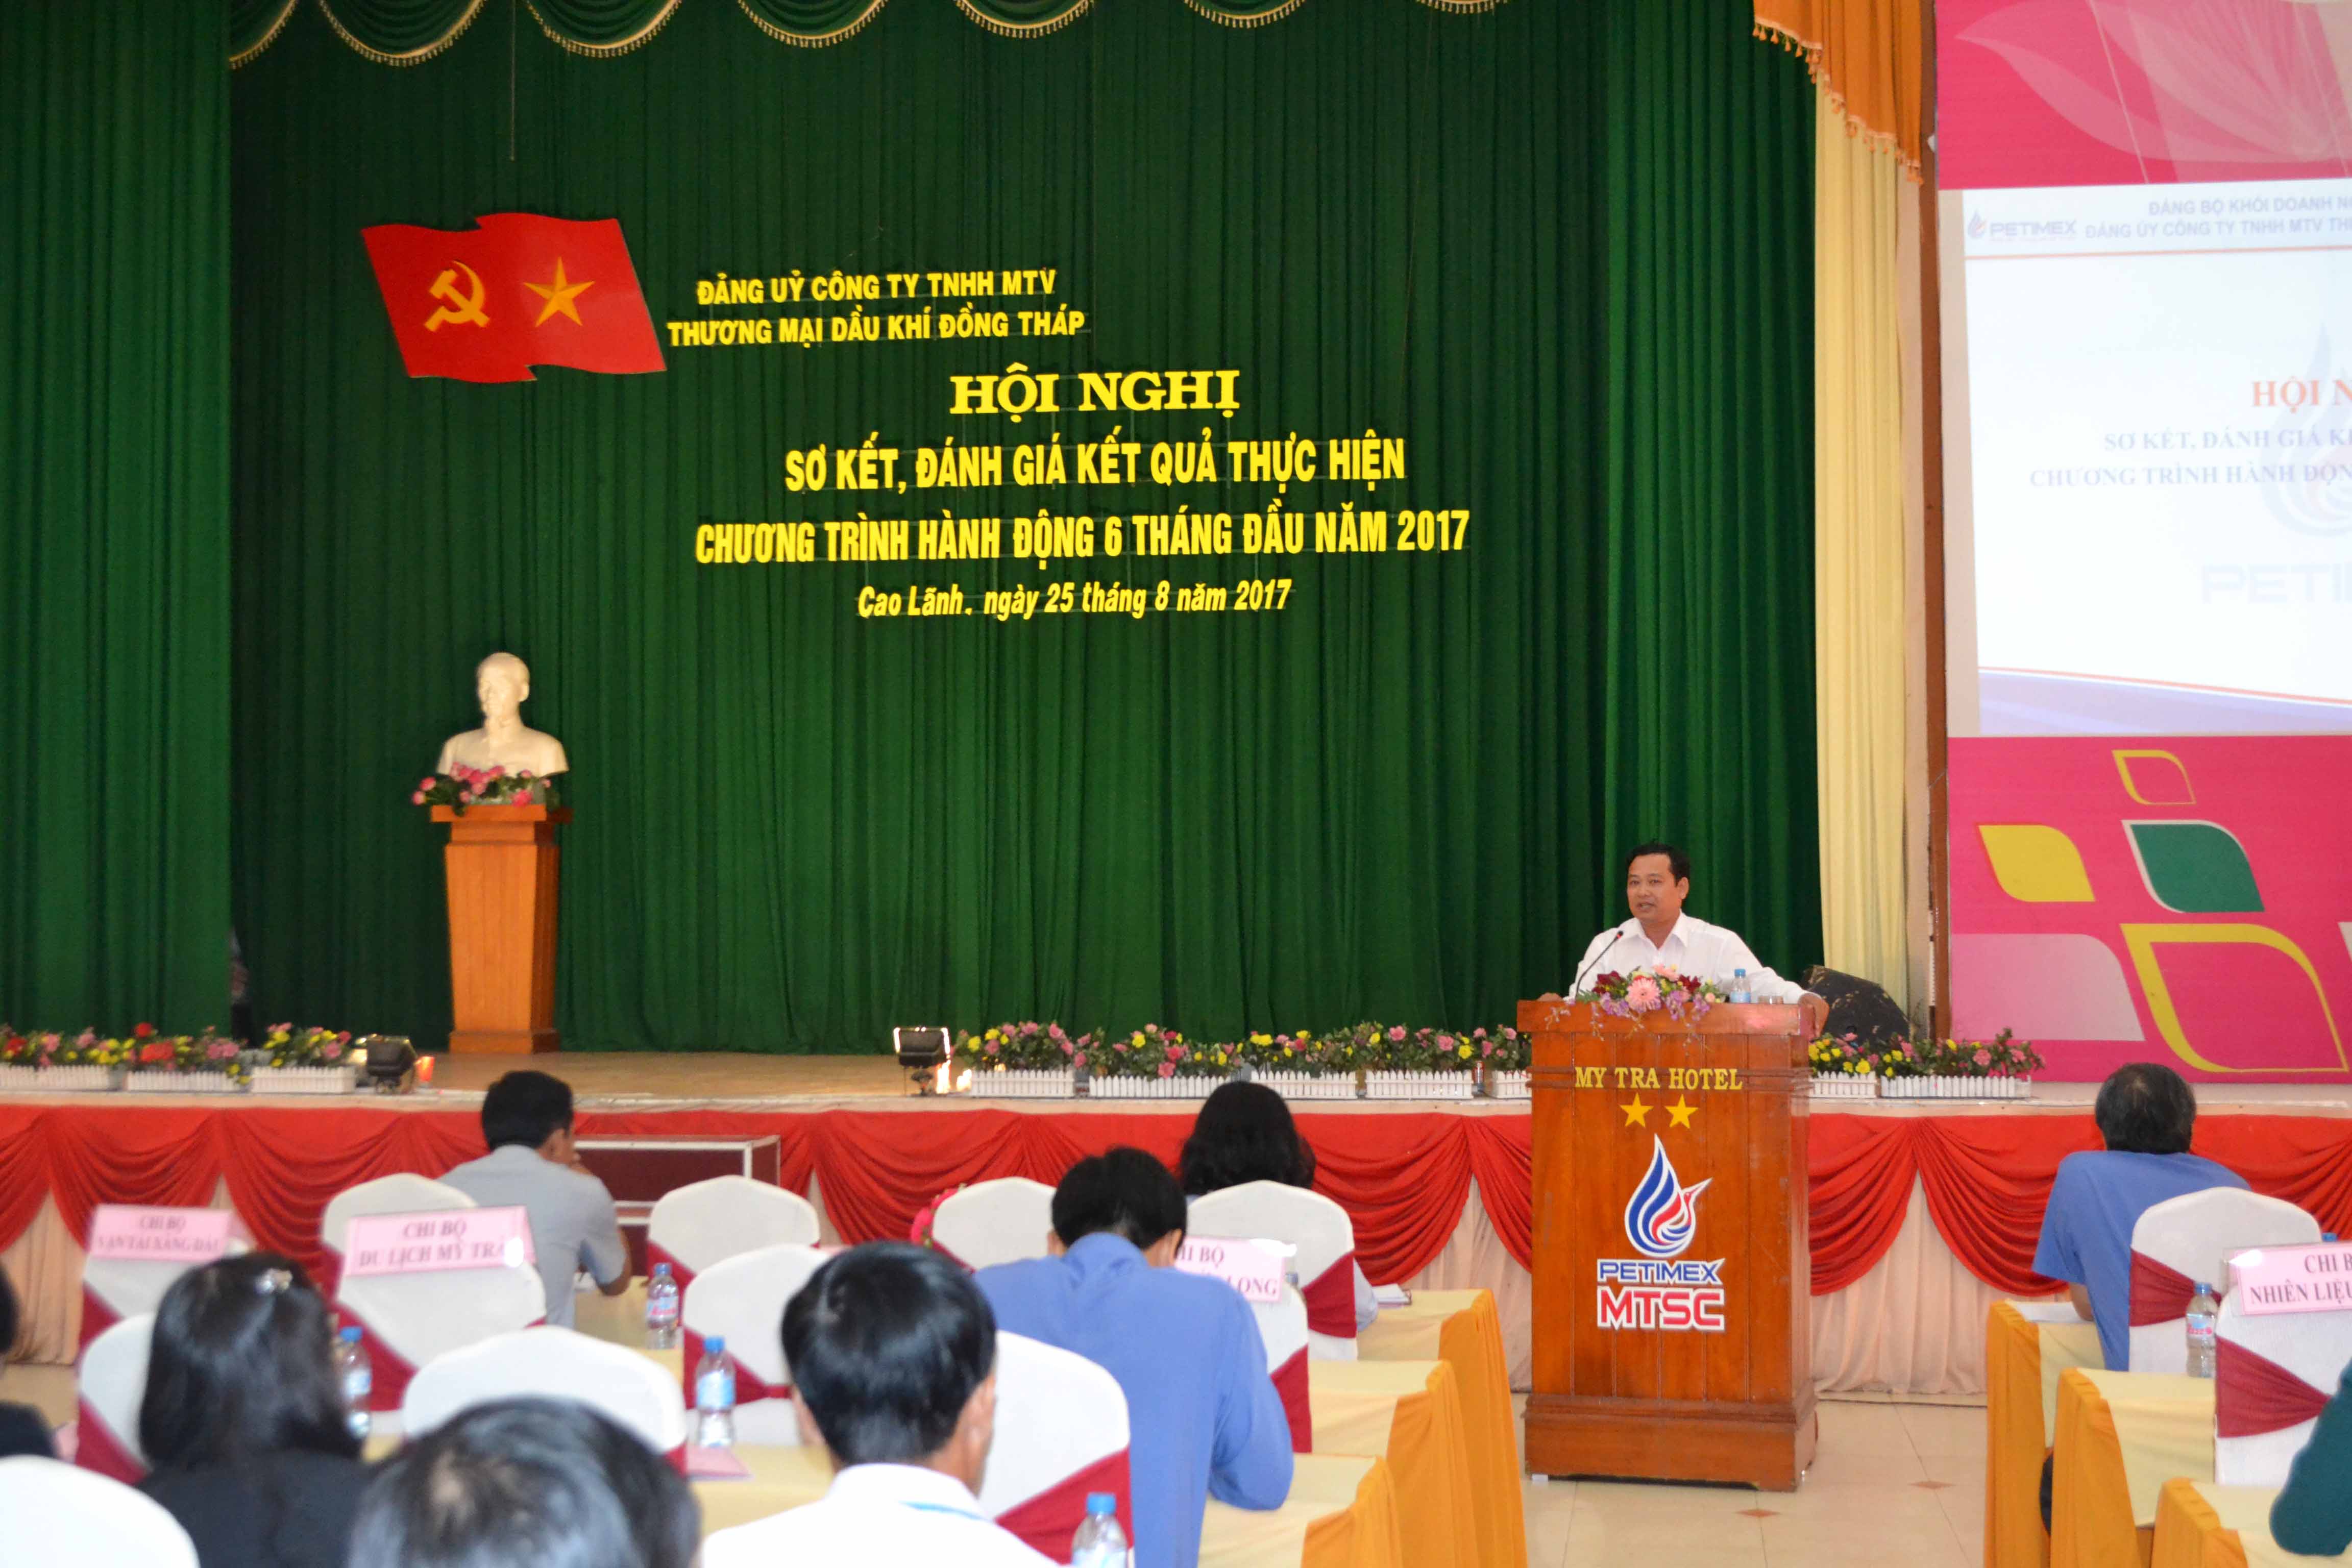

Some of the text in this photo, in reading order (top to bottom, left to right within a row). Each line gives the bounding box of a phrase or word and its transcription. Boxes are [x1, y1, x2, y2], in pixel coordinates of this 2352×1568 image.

[2273, 197, 2332, 212] DOANH
[1990, 219, 2077, 238] PETIMEX
[2163, 219, 2210, 237] CÔNG
[2216, 220, 2235, 235] TY
[2240, 219, 2284, 234] TNHH
[2289, 217, 2323, 233] MTV
[697, 273, 764, 304] ĐẢNG
[812, 271, 879, 301] CÔNG
[887, 274, 919, 298] TY
[927, 272, 993, 297] TNHH
[1002, 270, 1056, 295] MTV
[668, 302, 1084, 348] THƯƠNG MẠI DẦU KHÍ ĐỒNG THÁP
[950, 362, 1239, 422] HỘI NGHỊ
[2252, 376, 2319, 414] HỘI
[2104, 432, 2136, 451] SƠ
[2202, 426, 2269, 450] ĐÁNH
[2277, 425, 2322, 449] GIÁ
[786, 426, 1404, 494] SƠ KẾT, ĐÁNH GIÁ KẾT QUẢ THỰC HIỆN
[2030, 467, 2136, 487] CHƯƠNG
[2143, 461, 2218, 485] TRÌNH
[2226, 461, 2295, 484] HÀNH
[696, 499, 1469, 570] CHƯƠNG TRÌNH HÀNH ĐỘNG 6 THÁNG ĐẦU NĂM 2017
[859, 586, 901, 618] Cao
[984, 584, 1039, 621] ngày
[1044, 582, 1074, 612] 25
[1082, 581, 1146, 619] tháng
[1155, 580, 1170, 610] 8
[1177, 583, 1227, 611] năm
[1234, 579, 1291, 610] 2017
[1575, 1067, 1743, 1090] MY TRA HOTEL
[403, 1220, 435, 1238] CHI
[359, 1250, 379, 1266] DU
[1199, 1244, 1224, 1268] BỘ
[2304, 1254, 2338, 1273] CHI
[1598, 1259, 1724, 1284] PETIMEX
[2250, 1279, 2308, 1304] NHIÊN
[1599, 1288, 1723, 1329] MTSC
